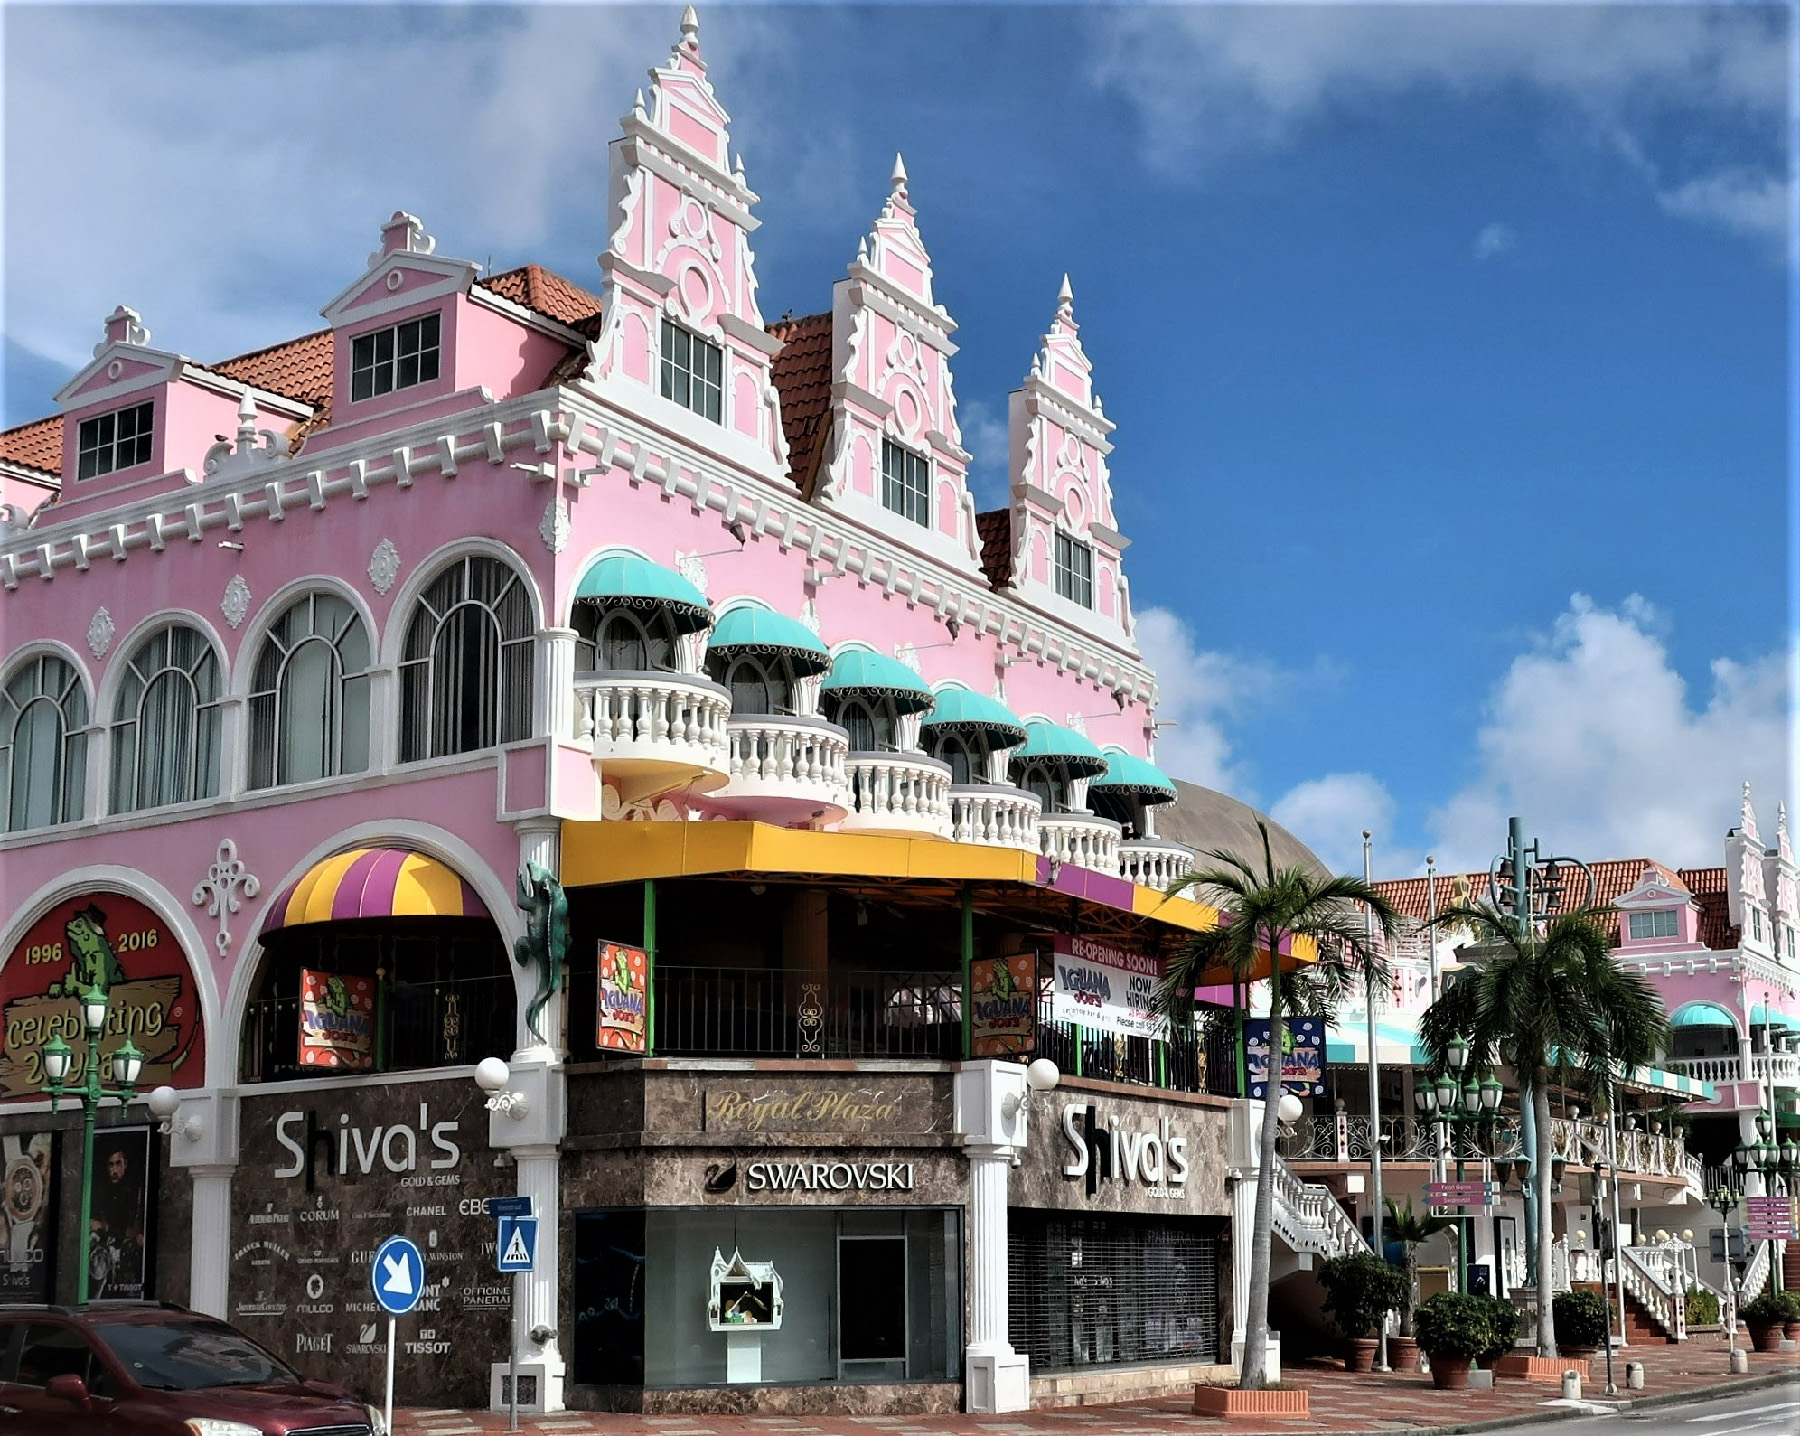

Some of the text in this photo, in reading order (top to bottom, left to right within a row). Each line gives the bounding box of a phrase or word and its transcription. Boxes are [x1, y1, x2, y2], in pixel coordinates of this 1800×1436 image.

[25, 928, 158, 965] 1996 2016
[1071, 938, 1158, 976] RE-OPENING SOON!
[1058, 964, 1112, 1001] IGUANA
[1129, 975, 1152, 994] NOW
[603, 988, 645, 1014] IGUANA
[1250, 1051, 1319, 1071] IGANA
[706, 1090, 895, 1132] Royal Plaza
[274, 1103, 460, 1193] Shiva's
[1062, 1103, 1189, 1196] Shiva's
[400, 1174, 460, 1188] GOLD & GEMS
[748, 1163, 915, 1190] SWAROVSKI
[300, 1209, 340, 1222] CORUM
[406, 1204, 447, 1217] CHANEL
[459, 1197, 491, 1216] EBE
[429, 1252, 464, 1262] WINSTON
[463, 1286, 511, 1296] OFFICINE
[463, 1296, 511, 1305] PANERAI
[295, 1333, 334, 1354] PIAGET
[345, 1343, 387, 1355] SWAROVSKI
[404, 1341, 452, 1354] TISSOT
